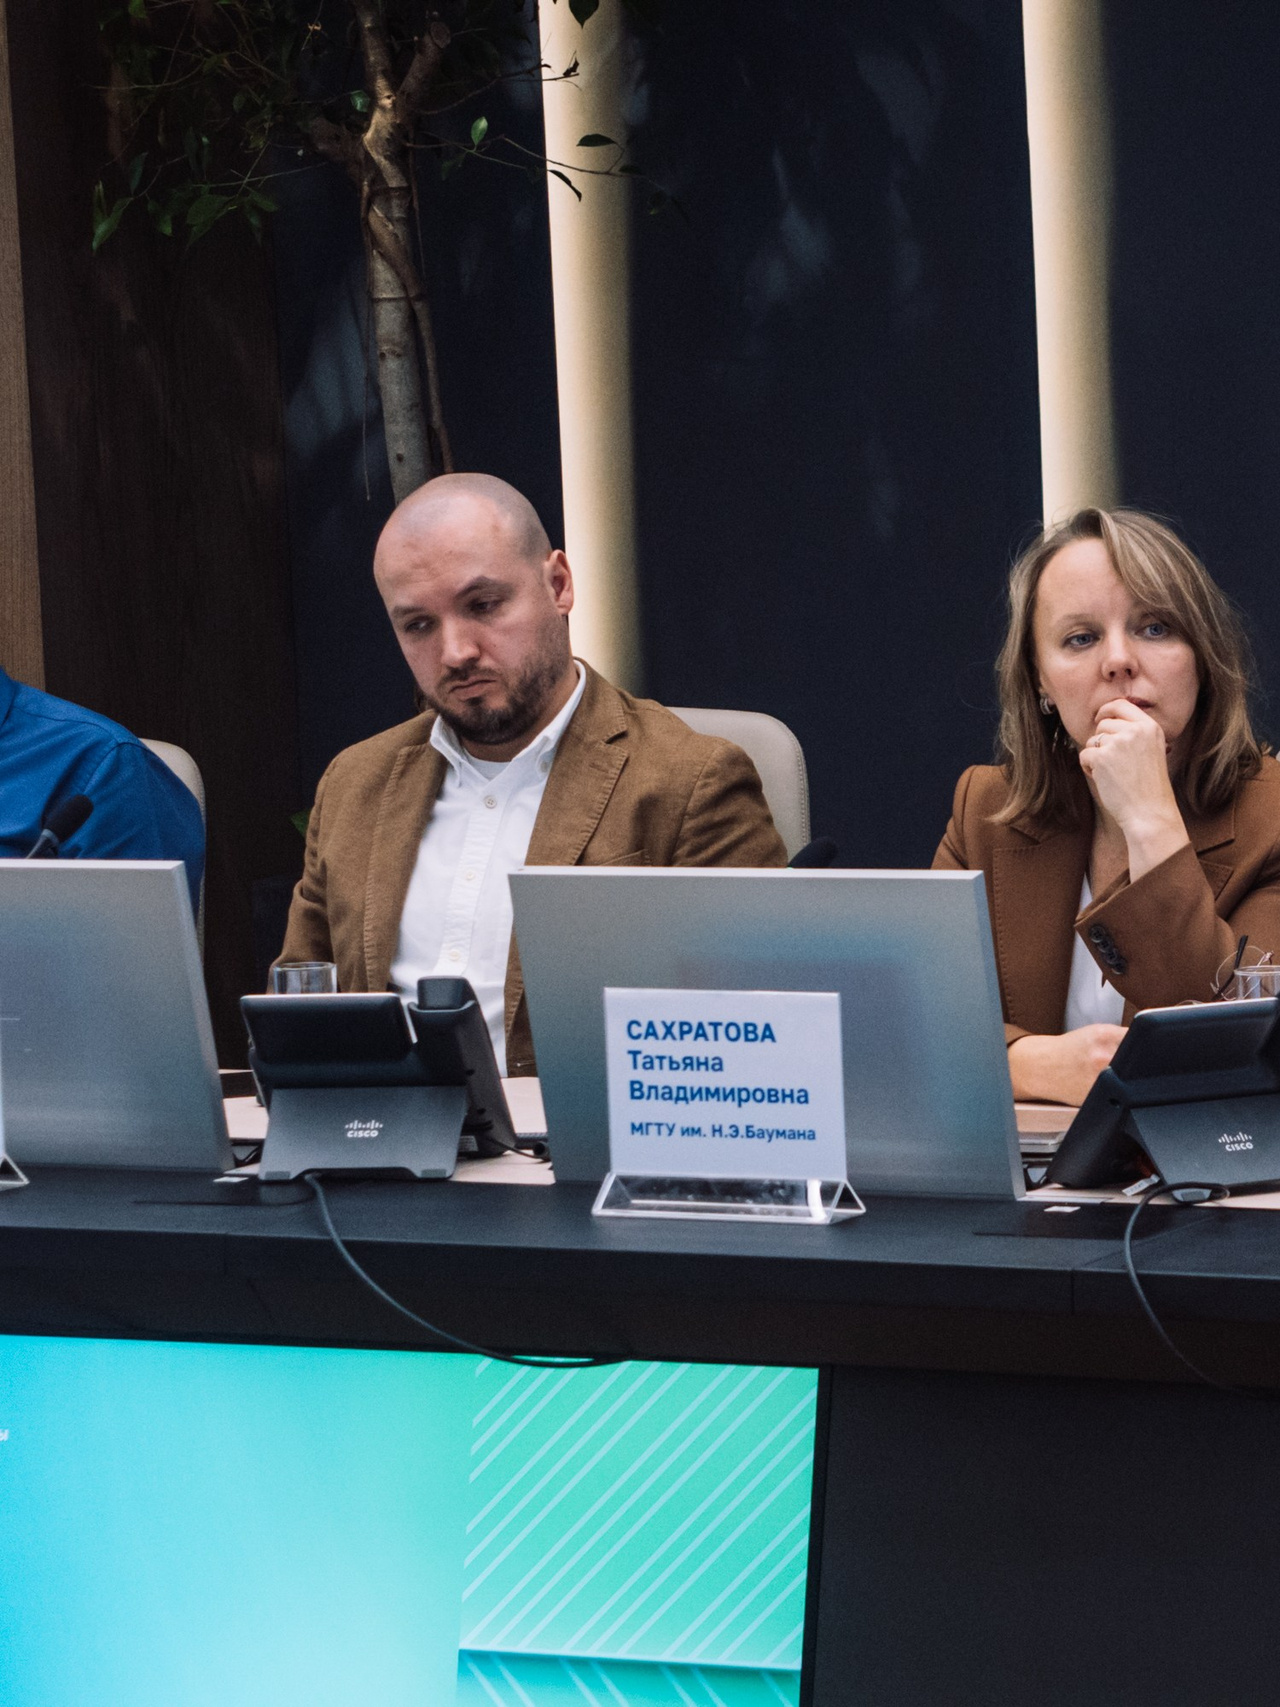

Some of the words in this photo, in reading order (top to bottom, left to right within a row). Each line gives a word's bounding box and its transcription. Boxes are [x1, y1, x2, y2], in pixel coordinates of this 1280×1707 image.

[627, 1019, 776, 1043] САХРАТОВА
[627, 1050, 724, 1072] Татьяна
[629, 1080, 809, 1107] Владимировна
[630, 1122, 676, 1137] МГТУ
[680, 1126, 707, 1138] им.
[711, 1124, 816, 1142] Н.Э.Баумана
